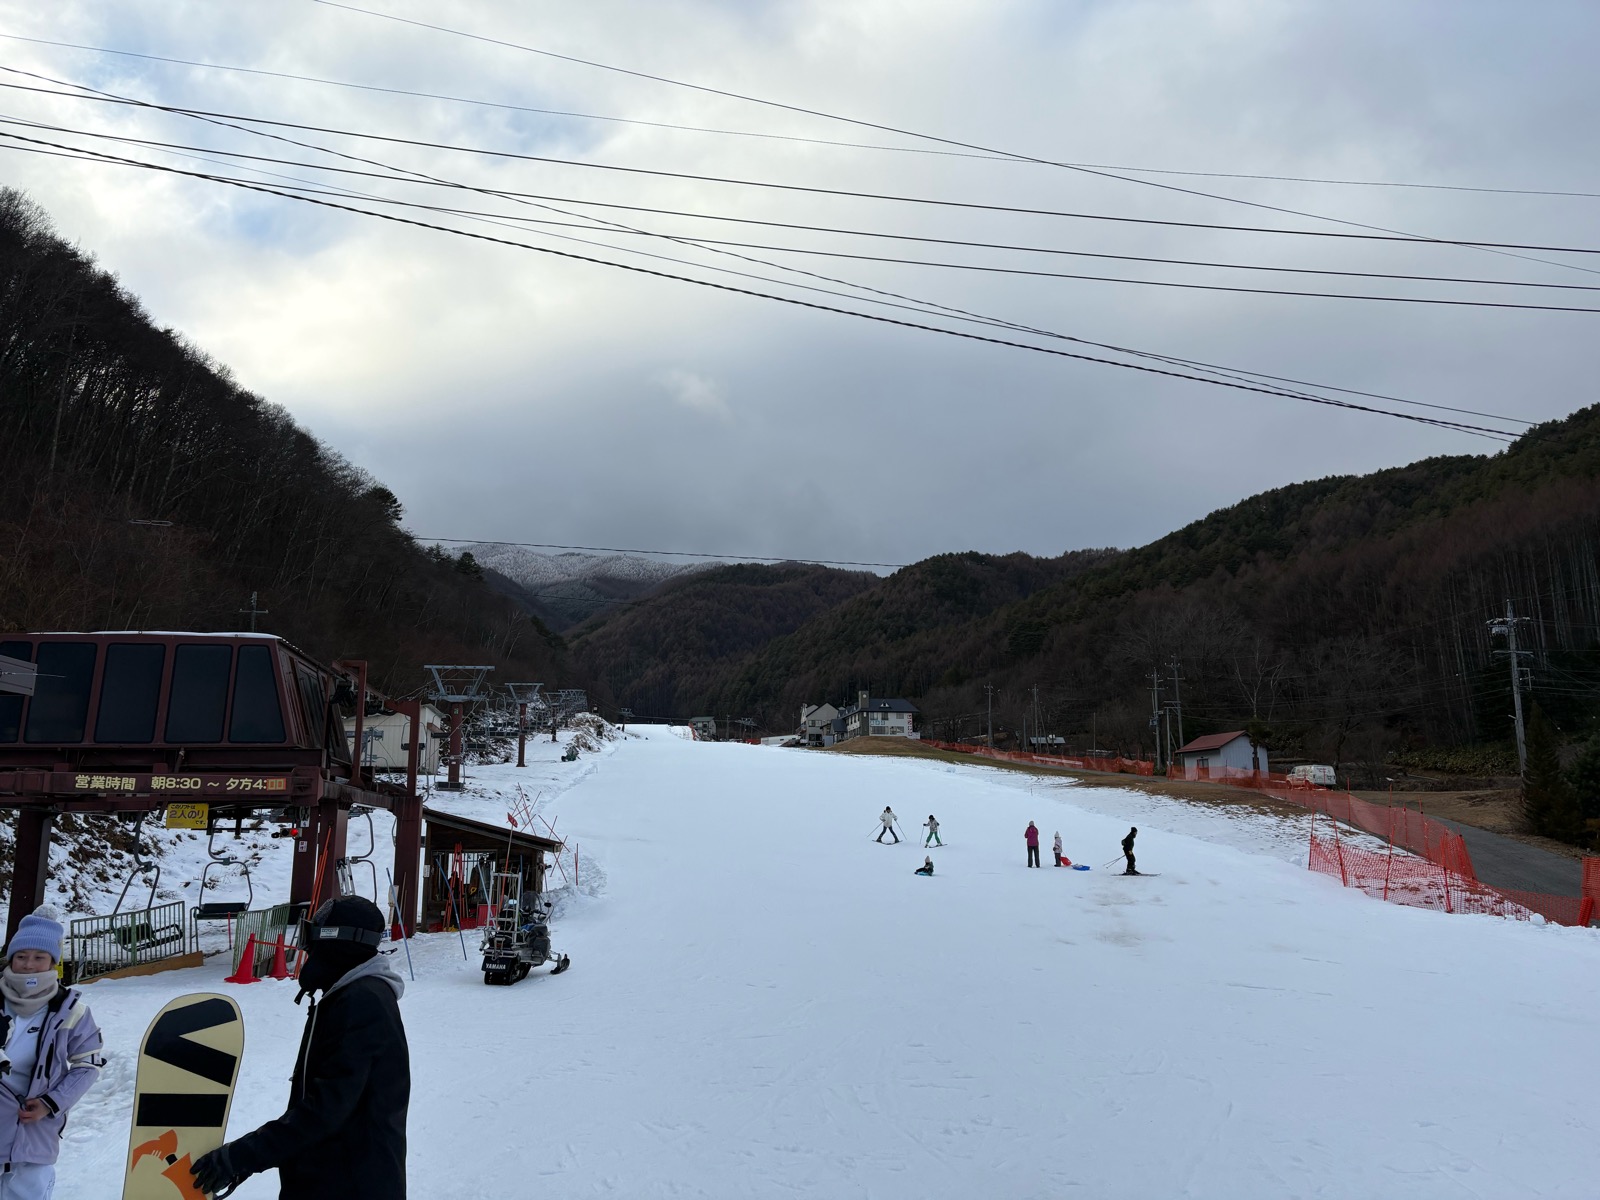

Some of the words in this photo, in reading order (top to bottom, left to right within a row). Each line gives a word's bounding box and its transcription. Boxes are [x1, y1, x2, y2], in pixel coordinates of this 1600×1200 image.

[75, 774, 136, 791] 営業時間
[151, 776, 201, 790] 朝8:30
[169, 810, 205, 819] 2人のり
